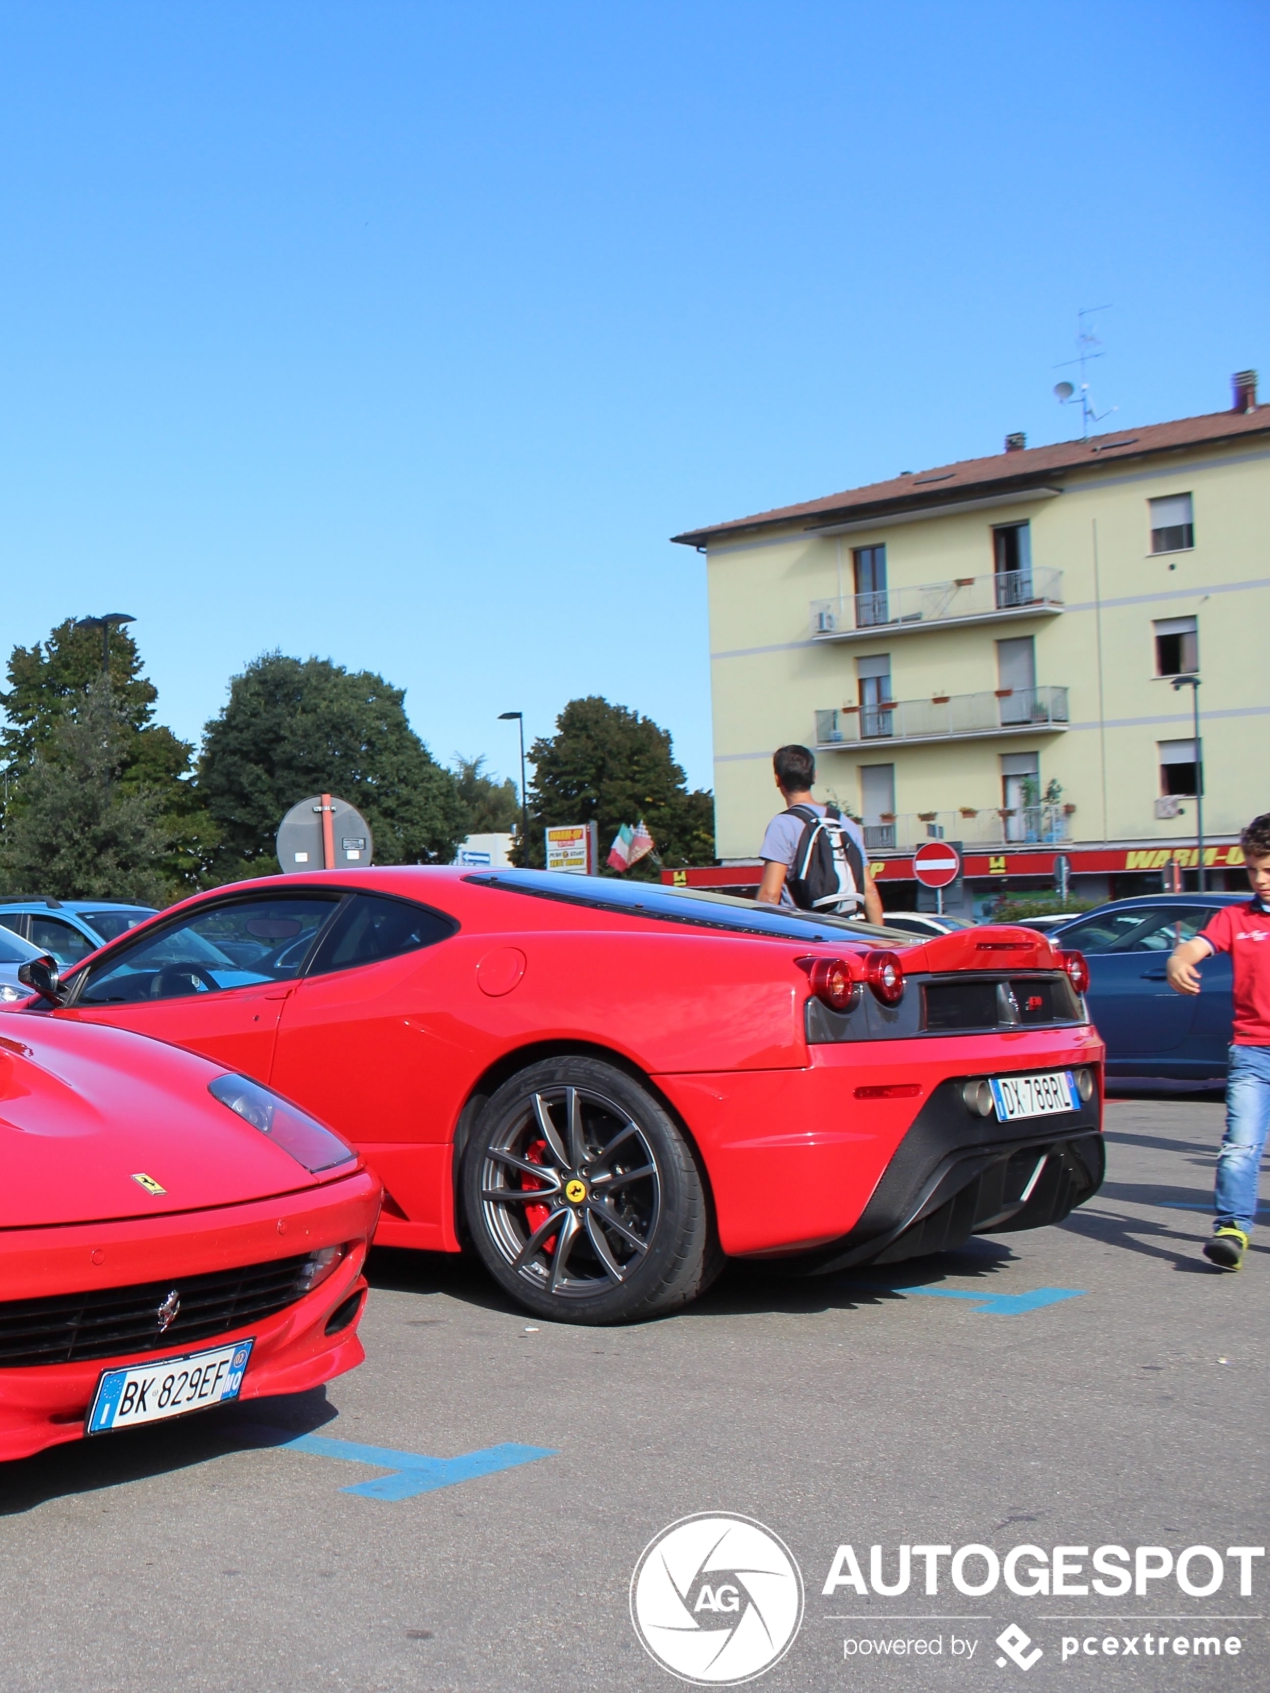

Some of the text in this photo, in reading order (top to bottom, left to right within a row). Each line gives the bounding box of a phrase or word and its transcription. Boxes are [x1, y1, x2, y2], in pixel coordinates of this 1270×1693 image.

[1125, 846, 1247, 870] WARM-U
[1025, 1076, 1070, 1112] 788RL
[118, 1377, 157, 1417] BK
[158, 1358, 231, 1409] 829EF
[222, 1370, 242, 1394] MO
